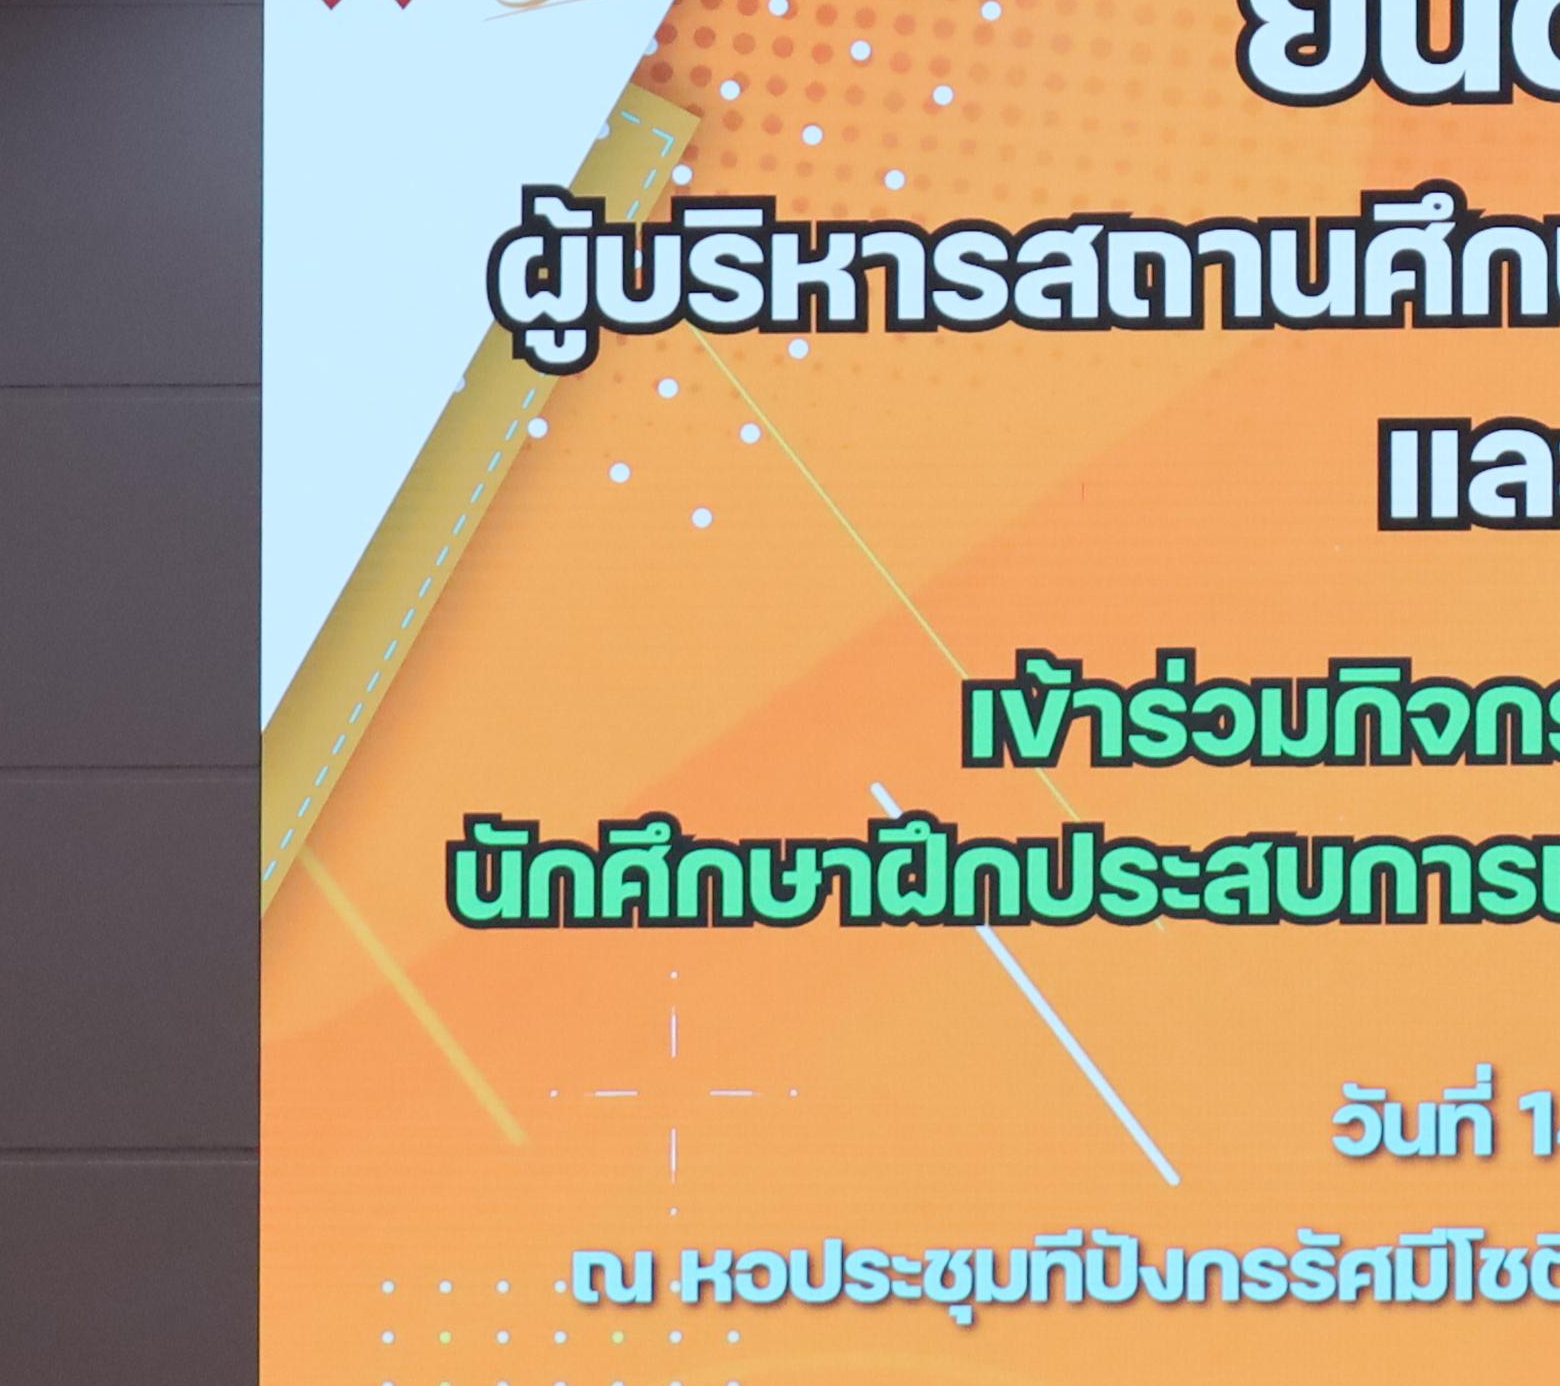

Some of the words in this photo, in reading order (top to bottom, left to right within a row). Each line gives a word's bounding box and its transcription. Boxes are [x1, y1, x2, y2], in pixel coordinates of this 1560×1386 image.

[1332, 1063, 1493, 1157] วันที่
[572, 1250, 654, 1304] ณ
